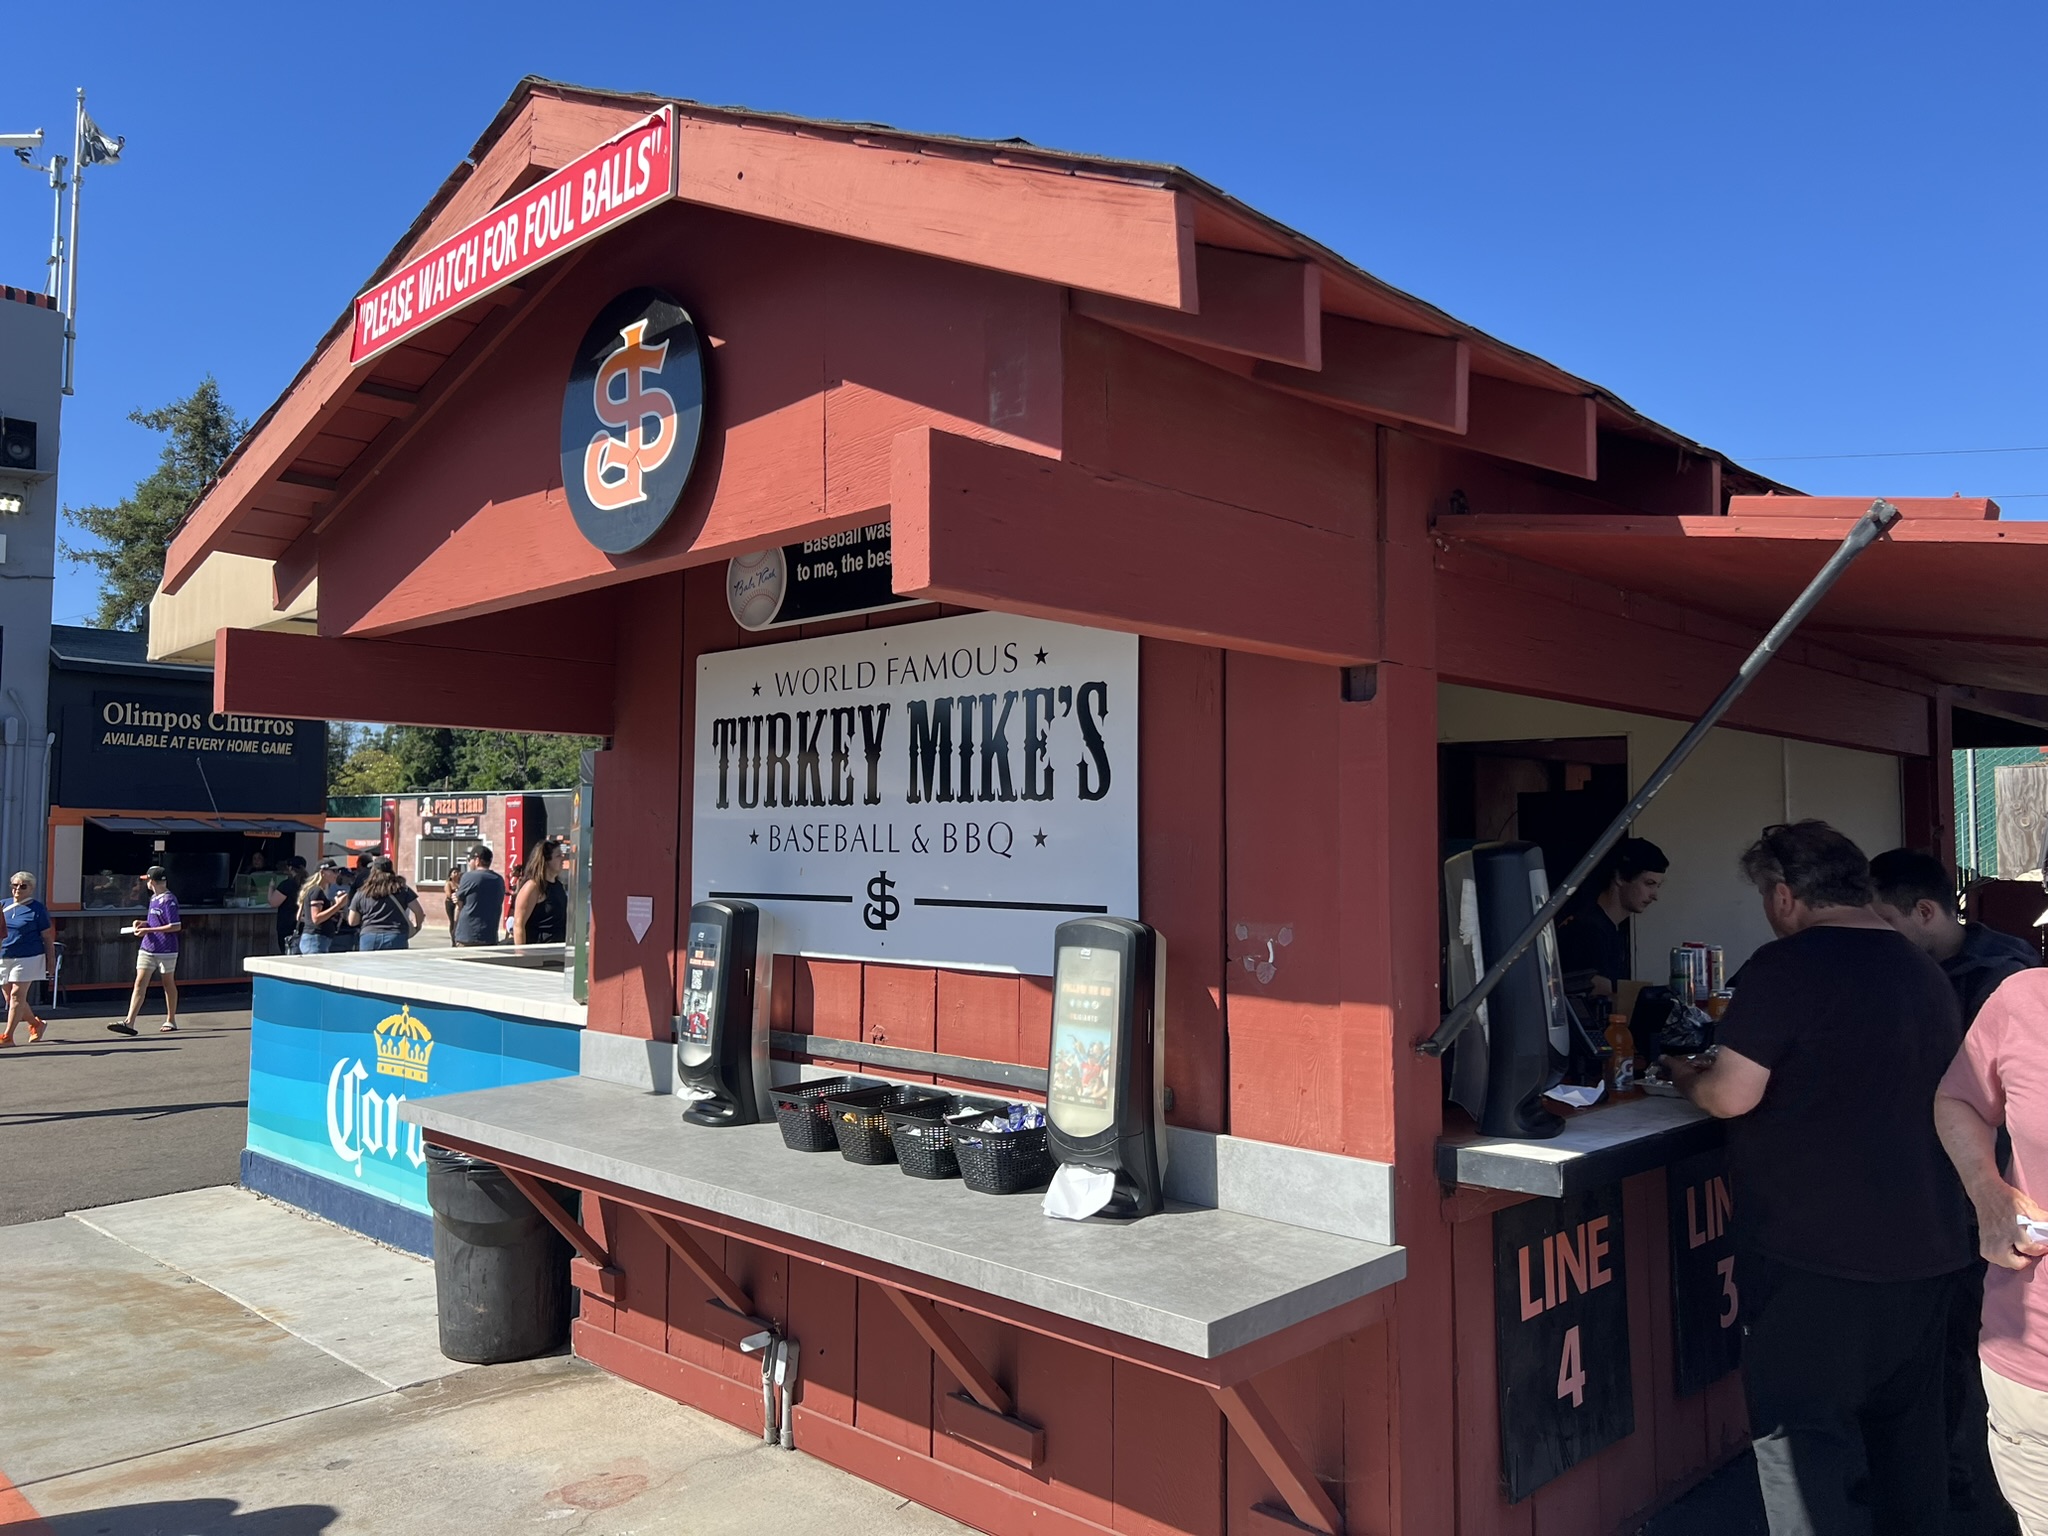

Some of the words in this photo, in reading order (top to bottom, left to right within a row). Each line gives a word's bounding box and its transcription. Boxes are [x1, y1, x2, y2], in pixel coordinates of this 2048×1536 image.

[360, 274, 415, 345] "PLEASE
[418, 235, 480, 314] WATCH
[481, 213, 519, 279] FOR
[523, 181, 575, 256] FOUL
[581, 127, 662, 225] BALLS"
[797, 563, 811, 582] to
[813, 561, 838, 579] me,
[841, 553, 864, 574] the
[867, 549, 892, 569] bes
[775, 661, 877, 698] WORLD
[886, 642, 1019, 686] FAMOUS
[102, 732, 169, 748] AVAILABLE
[170, 735, 186, 749] AT
[187, 737, 225, 751] EVERY
[226, 739, 259, 753] HOME
[261, 741, 293, 755] GAME
[103, 702, 201, 732] Olimpos
[207, 711, 295, 736] Churros
[712, 703, 891, 810] TURKEY
[906, 680, 1111, 804] MIKE'S
[768, 823, 901, 853] BASEBALL
[911, 824, 930, 854] &
[942, 821, 1014, 859] BBQ
[327, 1057, 428, 1178] Coro
[1686, 1176, 1733, 1249] LIN
[1518, 1215, 1612, 1322] LINE
[1717, 1255, 1739, 1328] 3
[1557, 1325, 1586, 1408] 4
